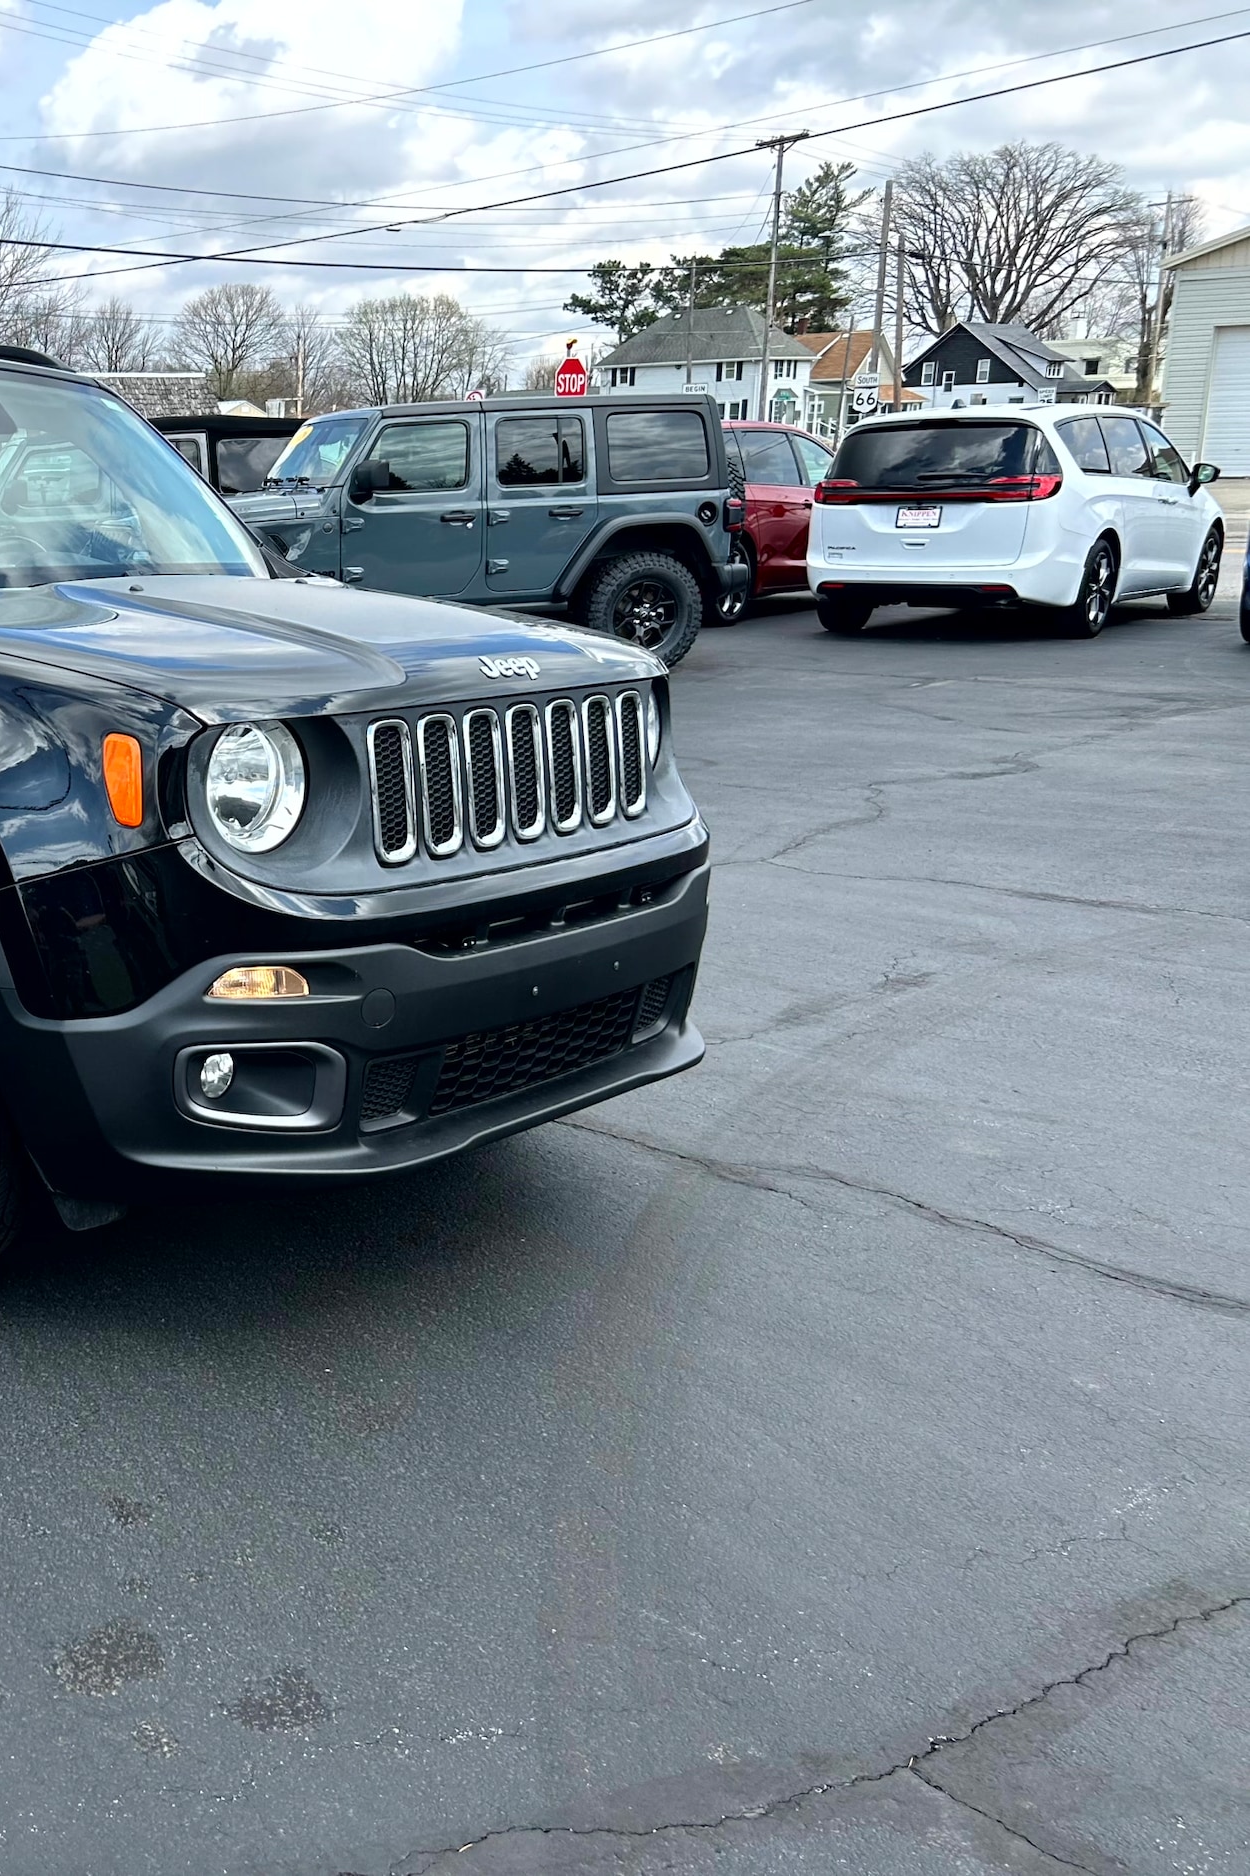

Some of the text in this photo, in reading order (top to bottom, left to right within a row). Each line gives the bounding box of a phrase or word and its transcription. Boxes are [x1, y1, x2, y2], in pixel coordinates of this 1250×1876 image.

[557, 373, 586, 393] STOP
[856, 375, 878, 385] SOUTH
[684, 385, 707, 393] BEGIN
[855, 392, 876, 406] 66
[901, 510, 937, 518] KNIPPEN
[478, 655, 541, 681] Jeep
